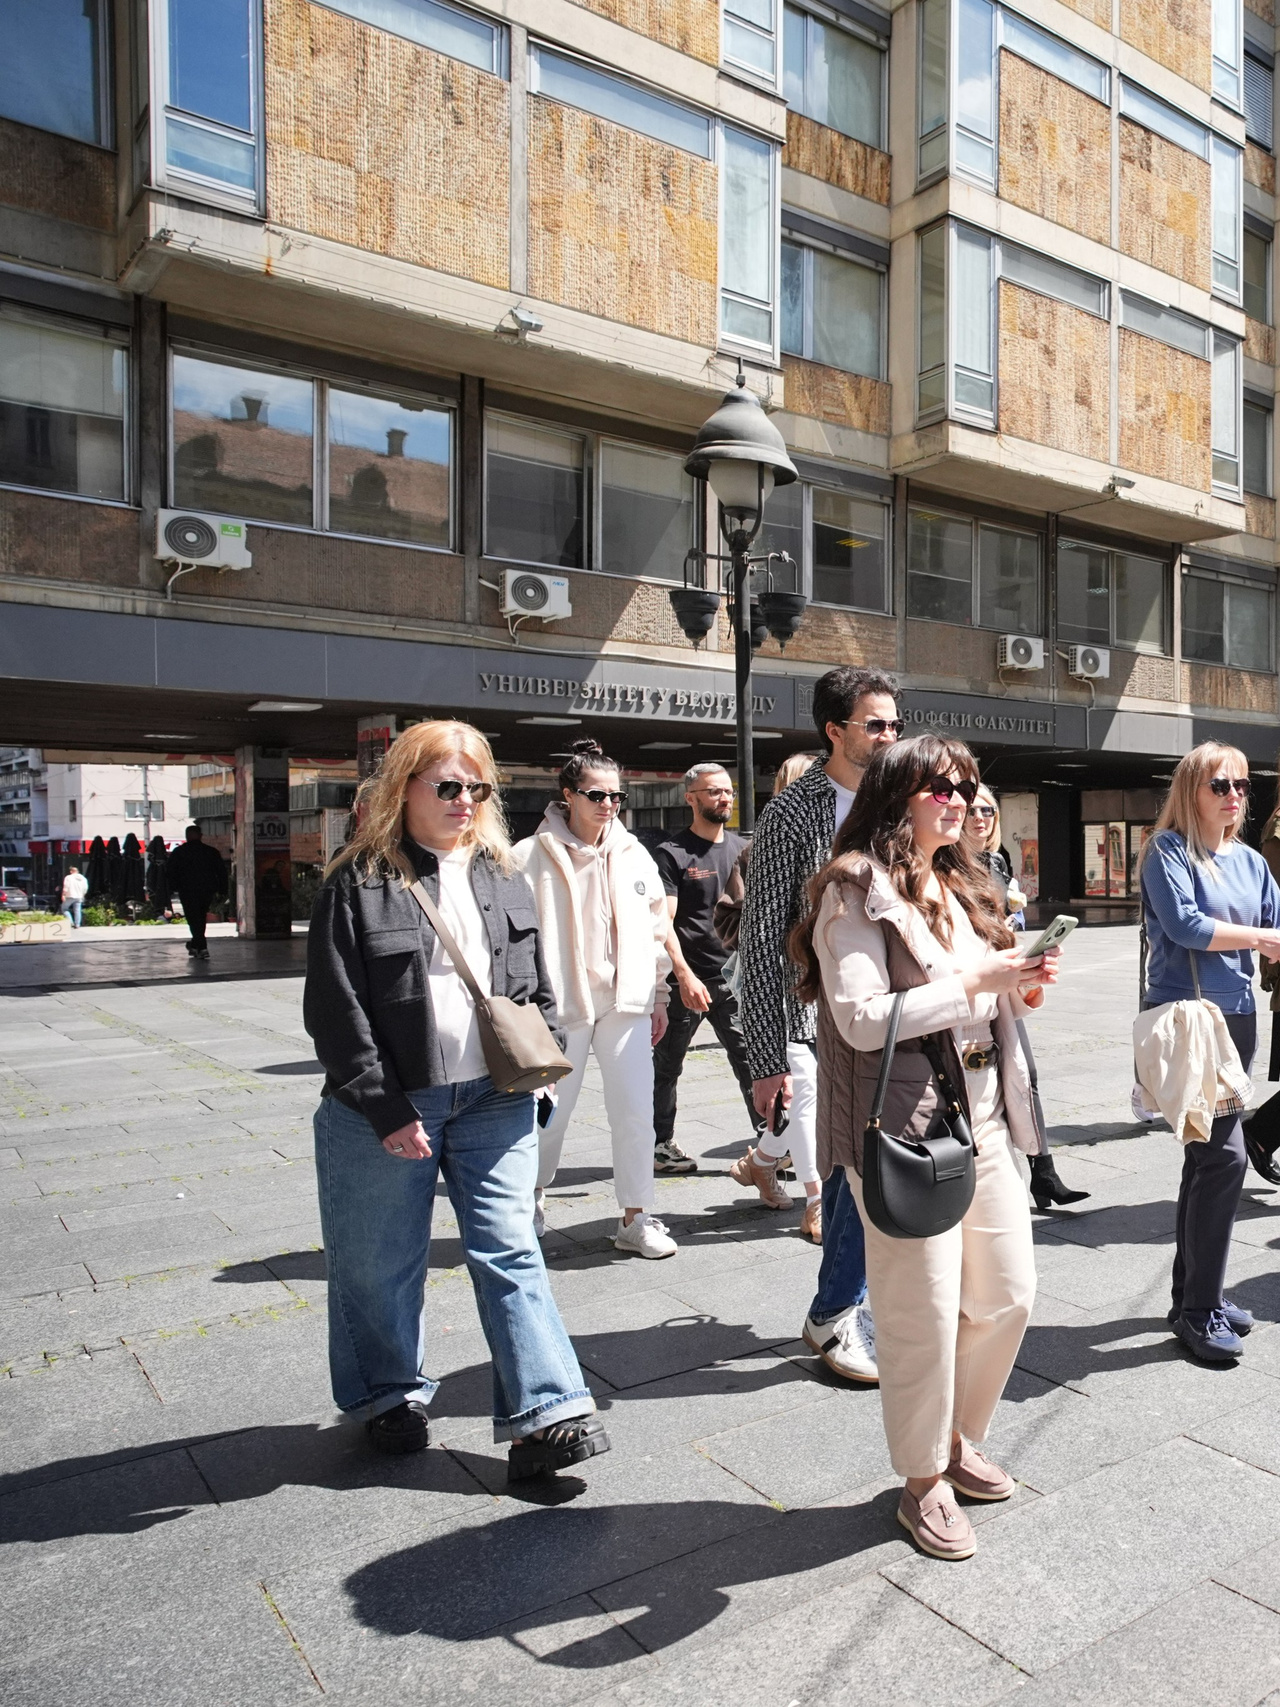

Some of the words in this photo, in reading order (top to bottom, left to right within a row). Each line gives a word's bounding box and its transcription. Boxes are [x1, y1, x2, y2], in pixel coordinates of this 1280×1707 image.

[480, 672, 651, 703] УНИВЕРЗИТЕТ
[656, 687, 670, 704] У
[675, 688, 777, 715] БЕОГРДУ
[898, 707, 971, 728] ЗОФСКИ
[975, 714, 1053, 735] ФАКУЛТЕТ
